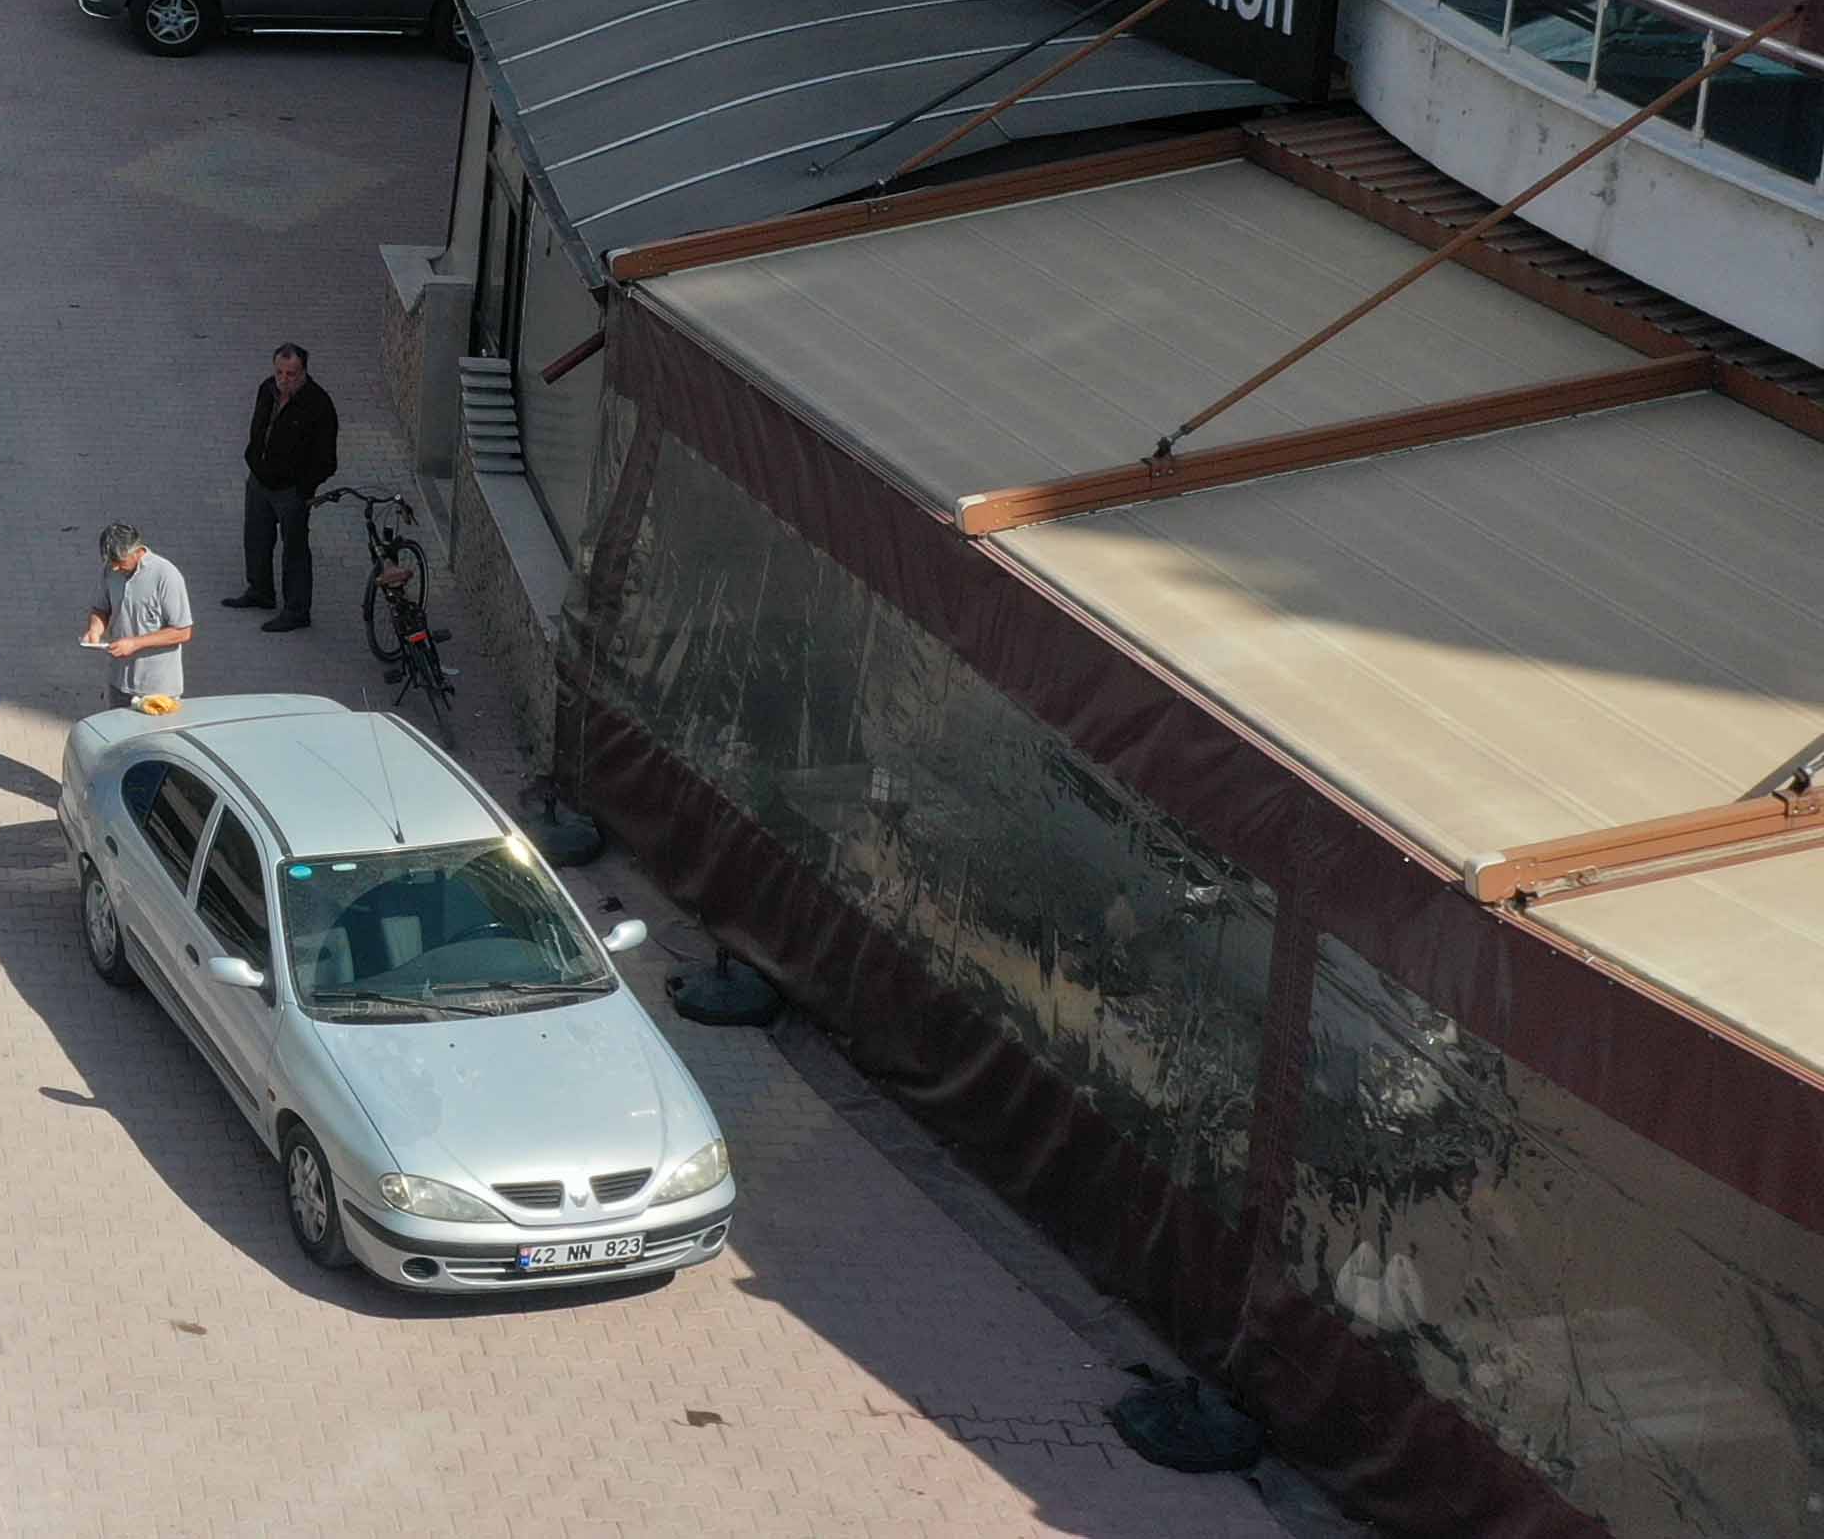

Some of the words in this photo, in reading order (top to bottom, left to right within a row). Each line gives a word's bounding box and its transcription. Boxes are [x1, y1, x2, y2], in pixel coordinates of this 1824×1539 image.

[531, 1247, 557, 1264] 42
[567, 1243, 593, 1262] NN
[604, 1237, 641, 1257] 823
